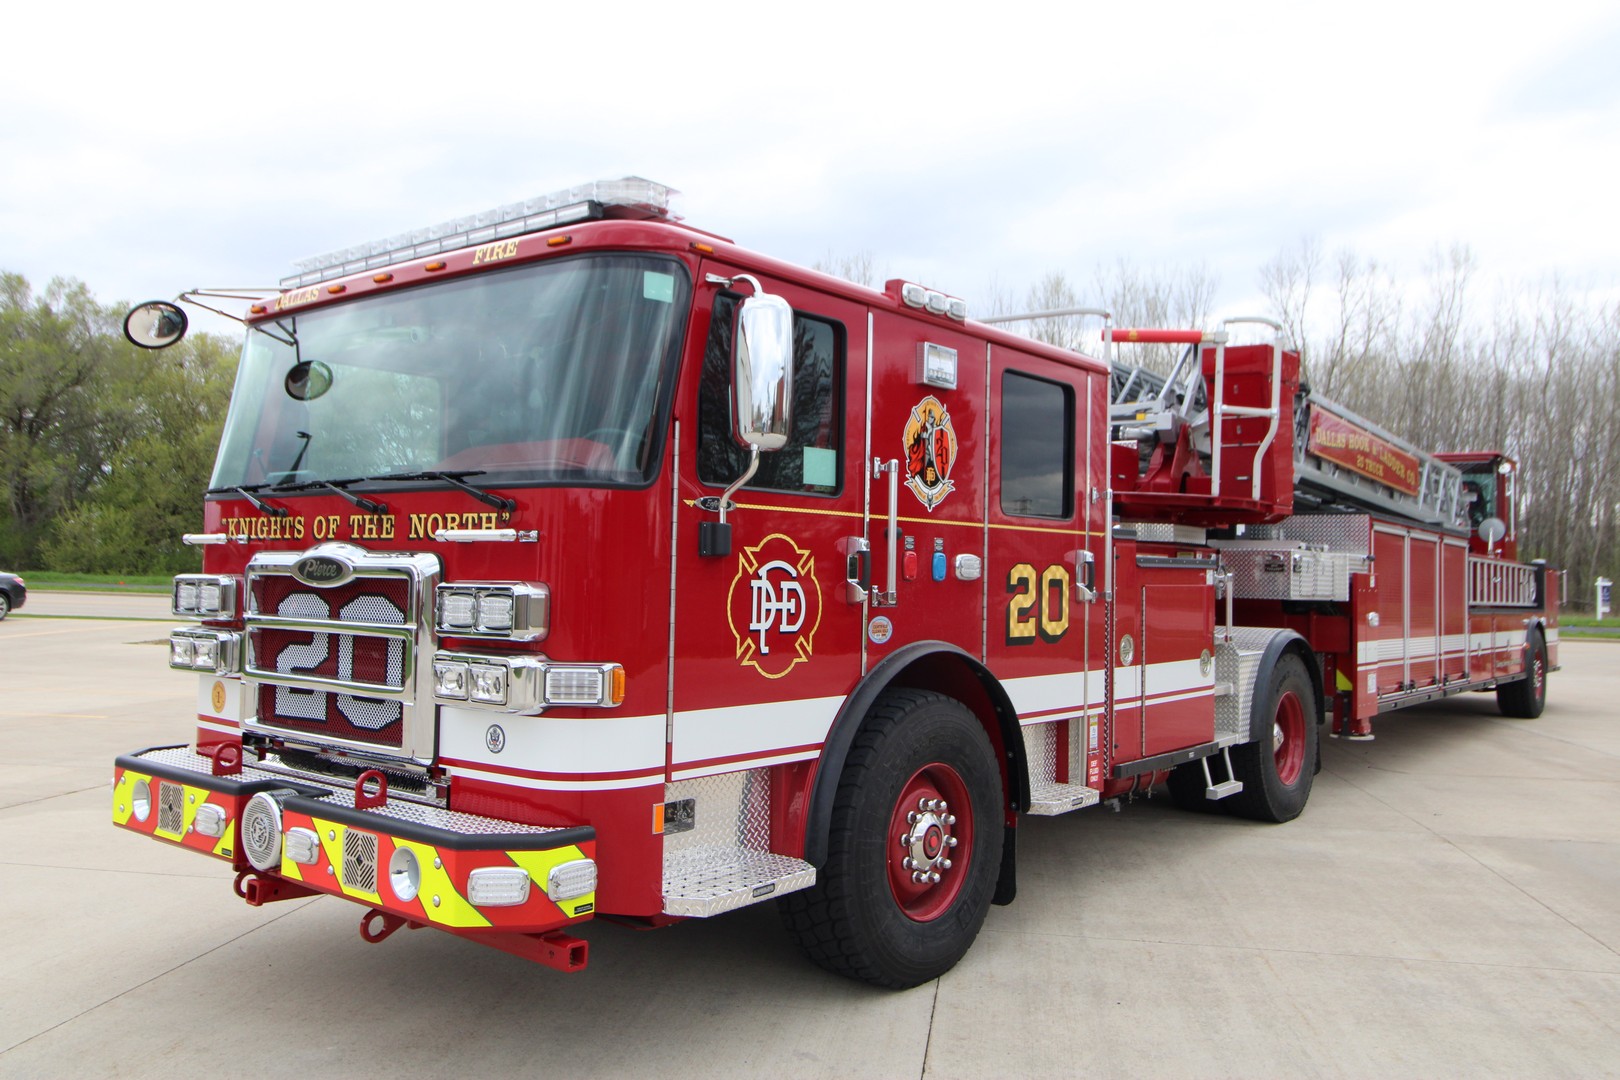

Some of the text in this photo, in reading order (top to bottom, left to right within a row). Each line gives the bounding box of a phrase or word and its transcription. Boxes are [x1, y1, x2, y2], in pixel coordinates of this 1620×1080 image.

[275, 240, 520, 310] DALLAS FIRE
[1315, 426, 1346, 448] DALLAS
[1348, 432, 1370, 453] HOOK
[1379, 446, 1405, 479] LADDER
[1365, 459, 1384, 477] TRUCK
[313, 515, 340, 539] OF
[350, 514, 395, 539] THE
[304, 559, 337, 578] Pierce
[1008, 563, 1070, 640] 20
[274, 593, 404, 729] 20
